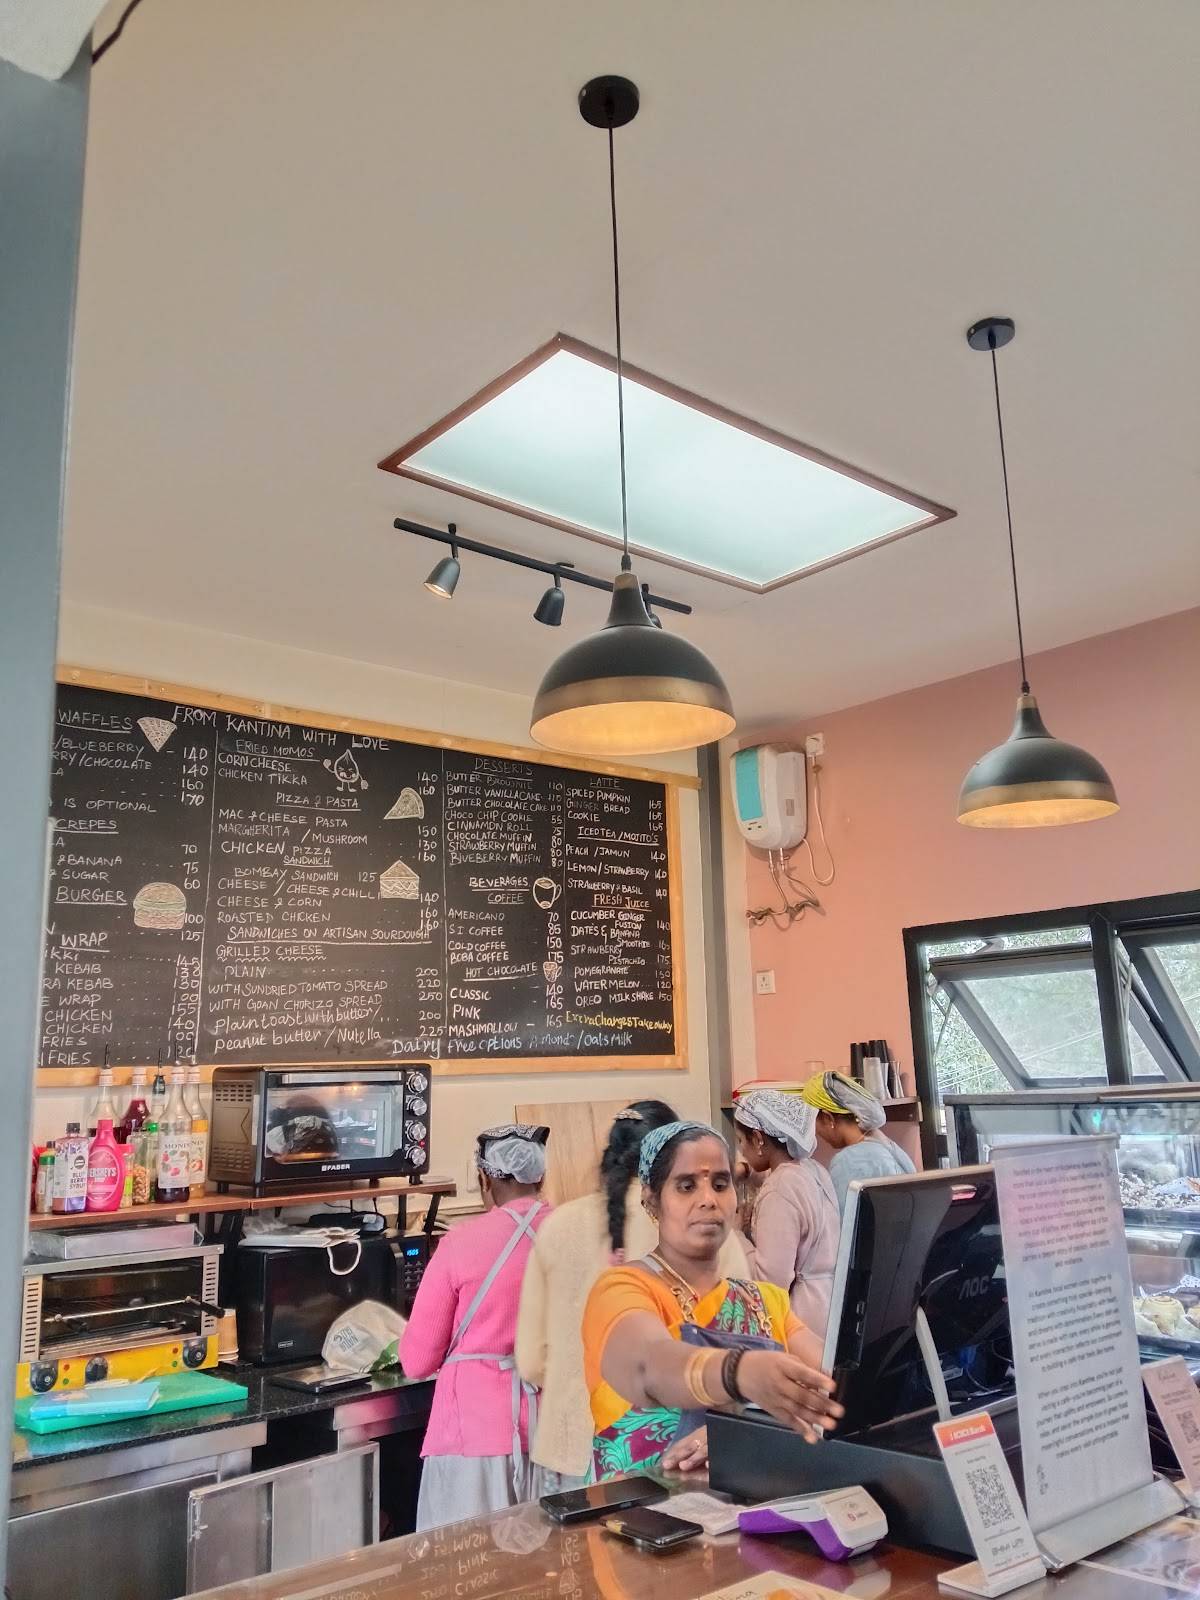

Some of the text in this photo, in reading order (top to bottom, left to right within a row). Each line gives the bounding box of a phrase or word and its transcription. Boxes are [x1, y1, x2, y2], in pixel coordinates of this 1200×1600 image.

[58, 708, 133, 731] WAFFLES
[172, 706, 390, 752] FROM KANTINA WITH LOVE
[183, 746, 208, 762] 140
[236, 739, 315, 759] FRIED MOMOS
[183, 765, 209, 778] 140
[474, 757, 533, 776] DESSERTS
[218, 769, 436, 796] CHICKEN 160
[417, 771, 439, 786] 140
[446, 770, 481, 783] BUTTER
[590, 777, 620, 788] LATTE
[182, 778, 204, 791] 160
[447, 783, 481, 796] BUTTER
[181, 791, 205, 807] 170
[566, 787, 595, 799] SPICED
[64, 798, 157, 813] IS OPTIONAL
[276, 792, 359, 808] PIZZA PASTA
[448, 798, 529, 811] BUTTER CHOCOLATE
[603, 803, 630, 815] BREAD
[444, 810, 534, 822] CHOCO CHIP COOKIE
[567, 811, 601, 822] COOKIE
[55, 818, 118, 831] CREPES
[219, 809, 437, 837] MAC PASTA 150
[447, 820, 534, 832] CINNAMON ROLL
[446, 831, 497, 842] CHOCOLATE
[577, 826, 600, 837] ICED
[181, 844, 198, 855] 70
[221, 841, 286, 855] CHICKEN
[293, 845, 331, 857] PIZZA
[448, 840, 506, 853] STRAWBERRY
[565, 843, 589, 856] PEACH
[283, 855, 330, 865] SANDWICH
[184, 862, 199, 875] 75
[62, 869, 110, 884] SUGAR
[184, 878, 201, 890] 60
[291, 871, 339, 882] SANDWICH
[359, 872, 378, 882] 125
[469, 876, 529, 888] BEVERAGES
[218, 877, 268, 890] CHEESE
[286, 884, 330, 896] CHEESE
[56, 886, 127, 903] BURGER
[487, 892, 525, 903] COFFEE
[593, 893, 650, 909] FRESH JUICE
[217, 897, 269, 908] CHEESE
[287, 898, 322, 908] CORN
[184, 912, 203, 925] 100
[217, 911, 331, 924] ROASTED CHICKEN
[447, 908, 505, 921] AMERICANO
[570, 910, 616, 921] CUCUMBER
[468, 926, 504, 937] COFFEE
[614, 919, 642, 931] FUSION
[62, 932, 108, 948] WRAP
[228, 926, 430, 941] SANDWICHES ON ARTISAN SOURDOUGH
[610, 928, 640, 940] BANANA
[474, 941, 507, 952] COFFEE
[546, 935, 563, 949] 150
[216, 944, 324, 957] GRILLED CHEESE
[476, 951, 510, 963] COFFEE
[55, 963, 102, 975] KEBAB
[224, 965, 439, 980] PLAIN 200
[465, 961, 538, 979] HOT CHOCOLATE
[67, 978, 114, 991] KEBAB
[208, 979, 441, 997] WITH SUNDRIED TOMATO SPREAD 220
[59, 994, 101, 1007] WRAP
[449, 987, 492, 1001] CLASSIC
[209, 991, 443, 1013] WITH GOAN CHORIZO SPREAD 250
[575, 994, 602, 1008] OREO
[45, 1009, 112, 1023] CHICKEN
[419, 1011, 441, 1021] 200
[452, 1004, 481, 1020] PINK
[46, 1023, 112, 1036] CHICKEN
[272, 1029, 322, 1046] butter
[420, 1025, 445, 1037] 225
[43, 1036, 88, 1049] FRIES
[391, 1038, 441, 1060] Dairy
[49, 1050, 92, 1065] FRIES
[959, 1275, 989, 1300] AOC
